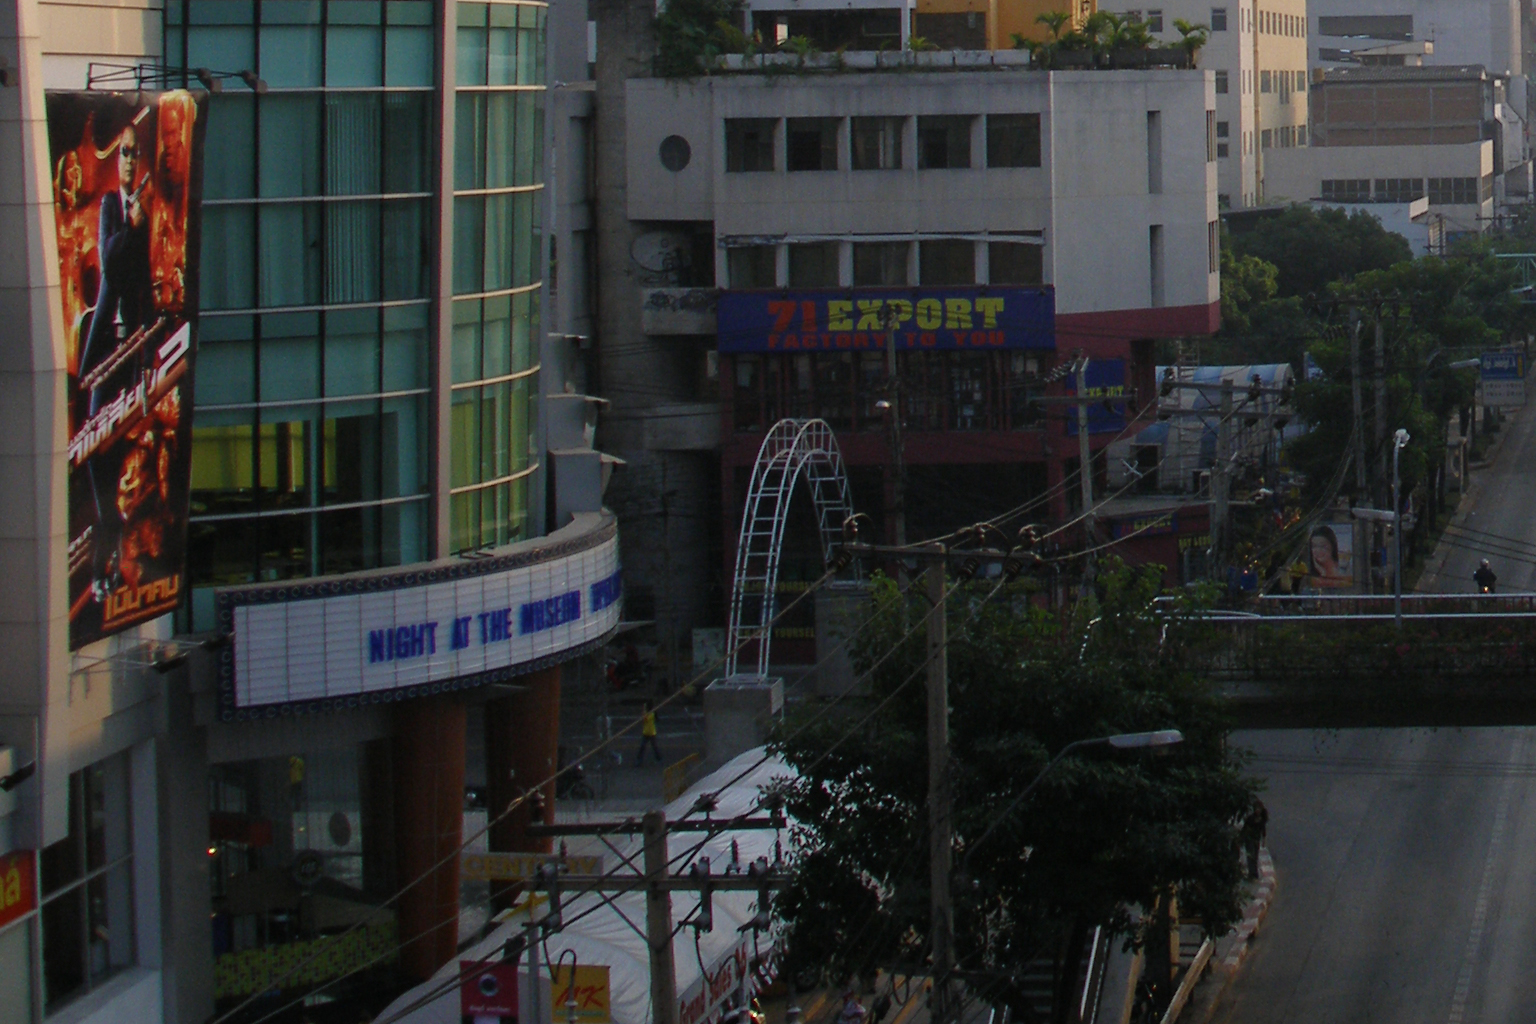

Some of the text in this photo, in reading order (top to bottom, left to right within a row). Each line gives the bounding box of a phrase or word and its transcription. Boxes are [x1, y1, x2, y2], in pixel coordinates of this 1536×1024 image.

[767, 297, 1005, 332] 71 EXPORT
[157, 320, 191, 382] 2
[767, 331, 1005, 349] FACTORY TO YOU
[369, 622, 438, 664] NIGHT
[449, 616, 473, 651] AT
[477, 607, 512, 645] THE
